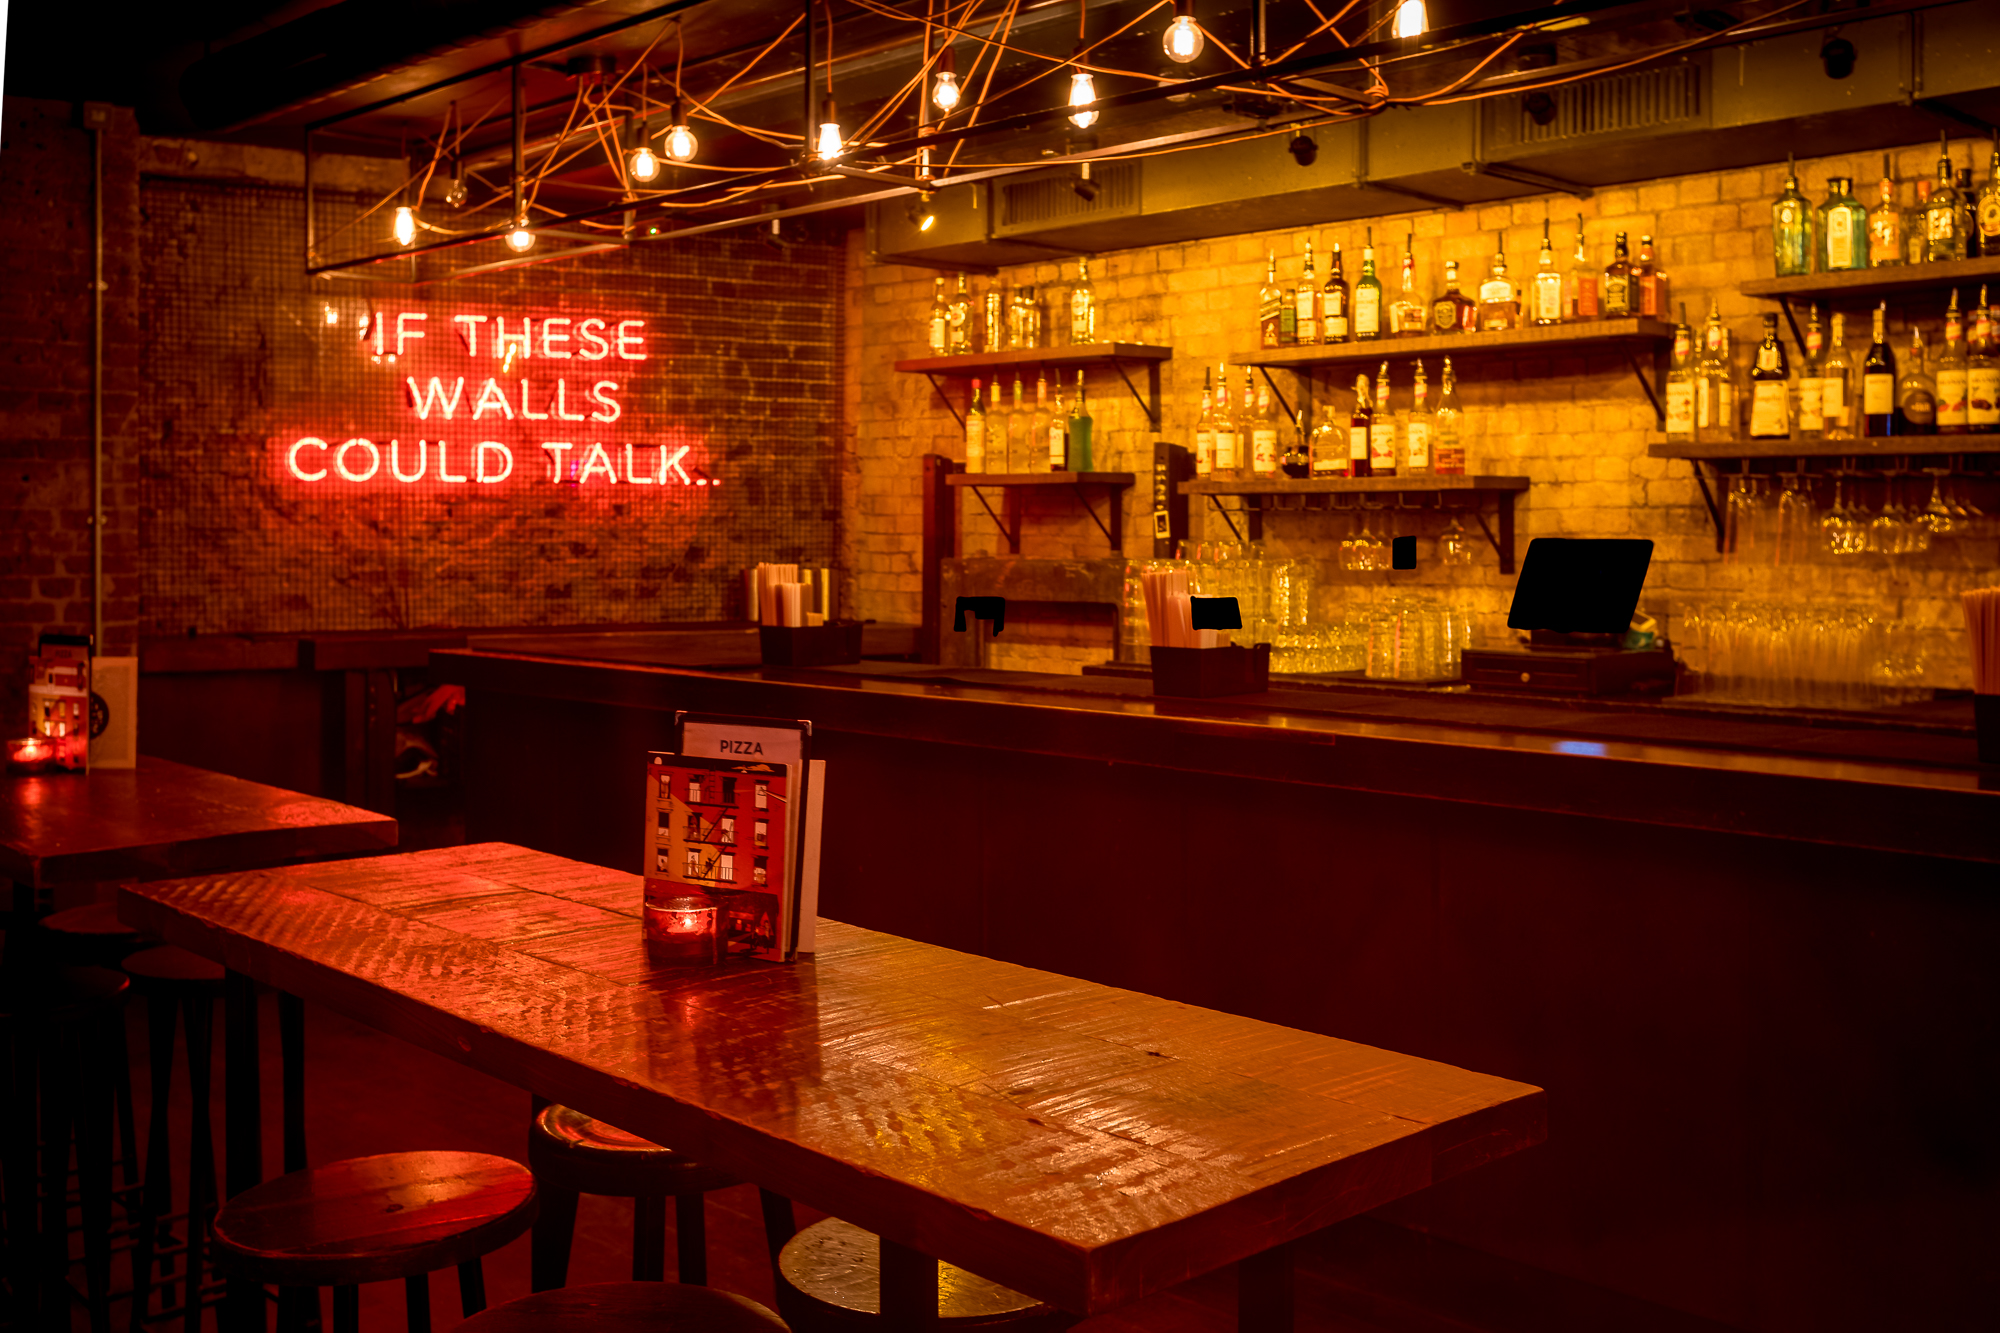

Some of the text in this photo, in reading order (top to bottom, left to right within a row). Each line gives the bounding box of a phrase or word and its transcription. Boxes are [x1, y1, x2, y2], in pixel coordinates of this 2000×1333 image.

[374, 311, 648, 361] IF THESE
[406, 376, 622, 423] WALLS
[287, 437, 513, 484] COULD
[720, 739, 764, 756] PIZZA
